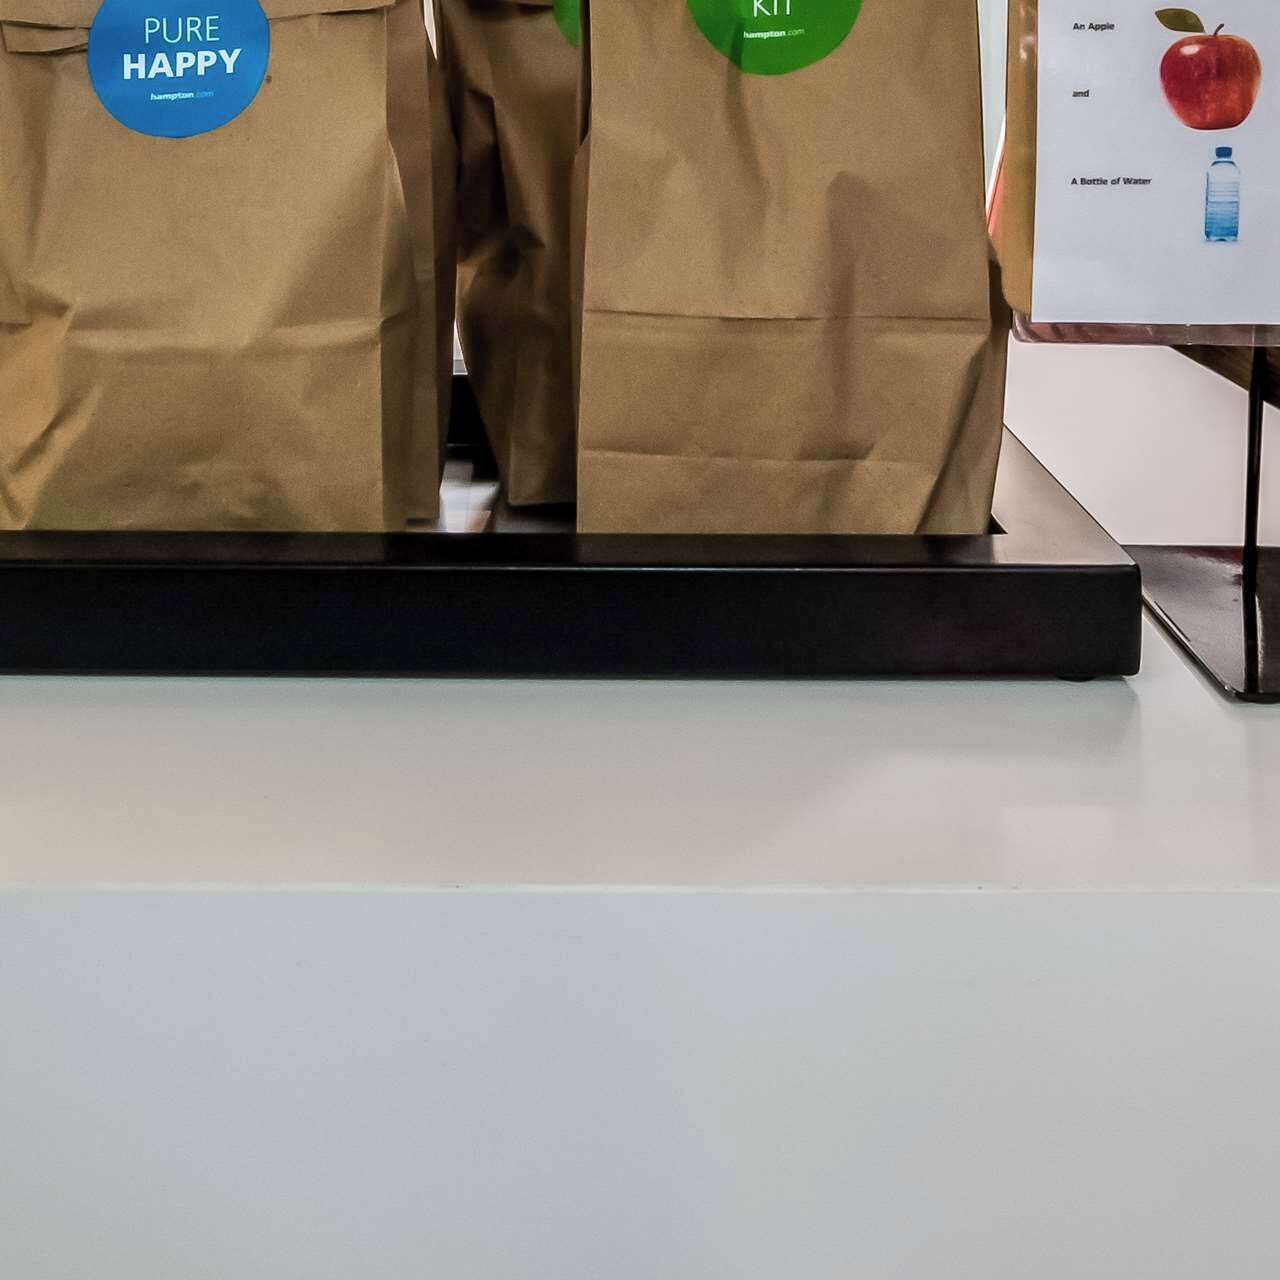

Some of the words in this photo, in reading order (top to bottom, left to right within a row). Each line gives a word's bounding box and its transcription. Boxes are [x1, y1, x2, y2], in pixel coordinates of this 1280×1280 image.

[144, 15, 220, 44] PURE
[1088, 22, 1115, 32] Apple
[743, 28, 805, 40] hampton.com
[123, 48, 242, 80] HAPPY
[150, 90, 214, 101] hampton.com
[1072, 89, 1090, 98] and
[1071, 177, 1078, 185] A
[1080, 177, 1108, 186] Bottle
[1110, 177, 1121, 186] of
[1122, 177, 1152, 185] Water
